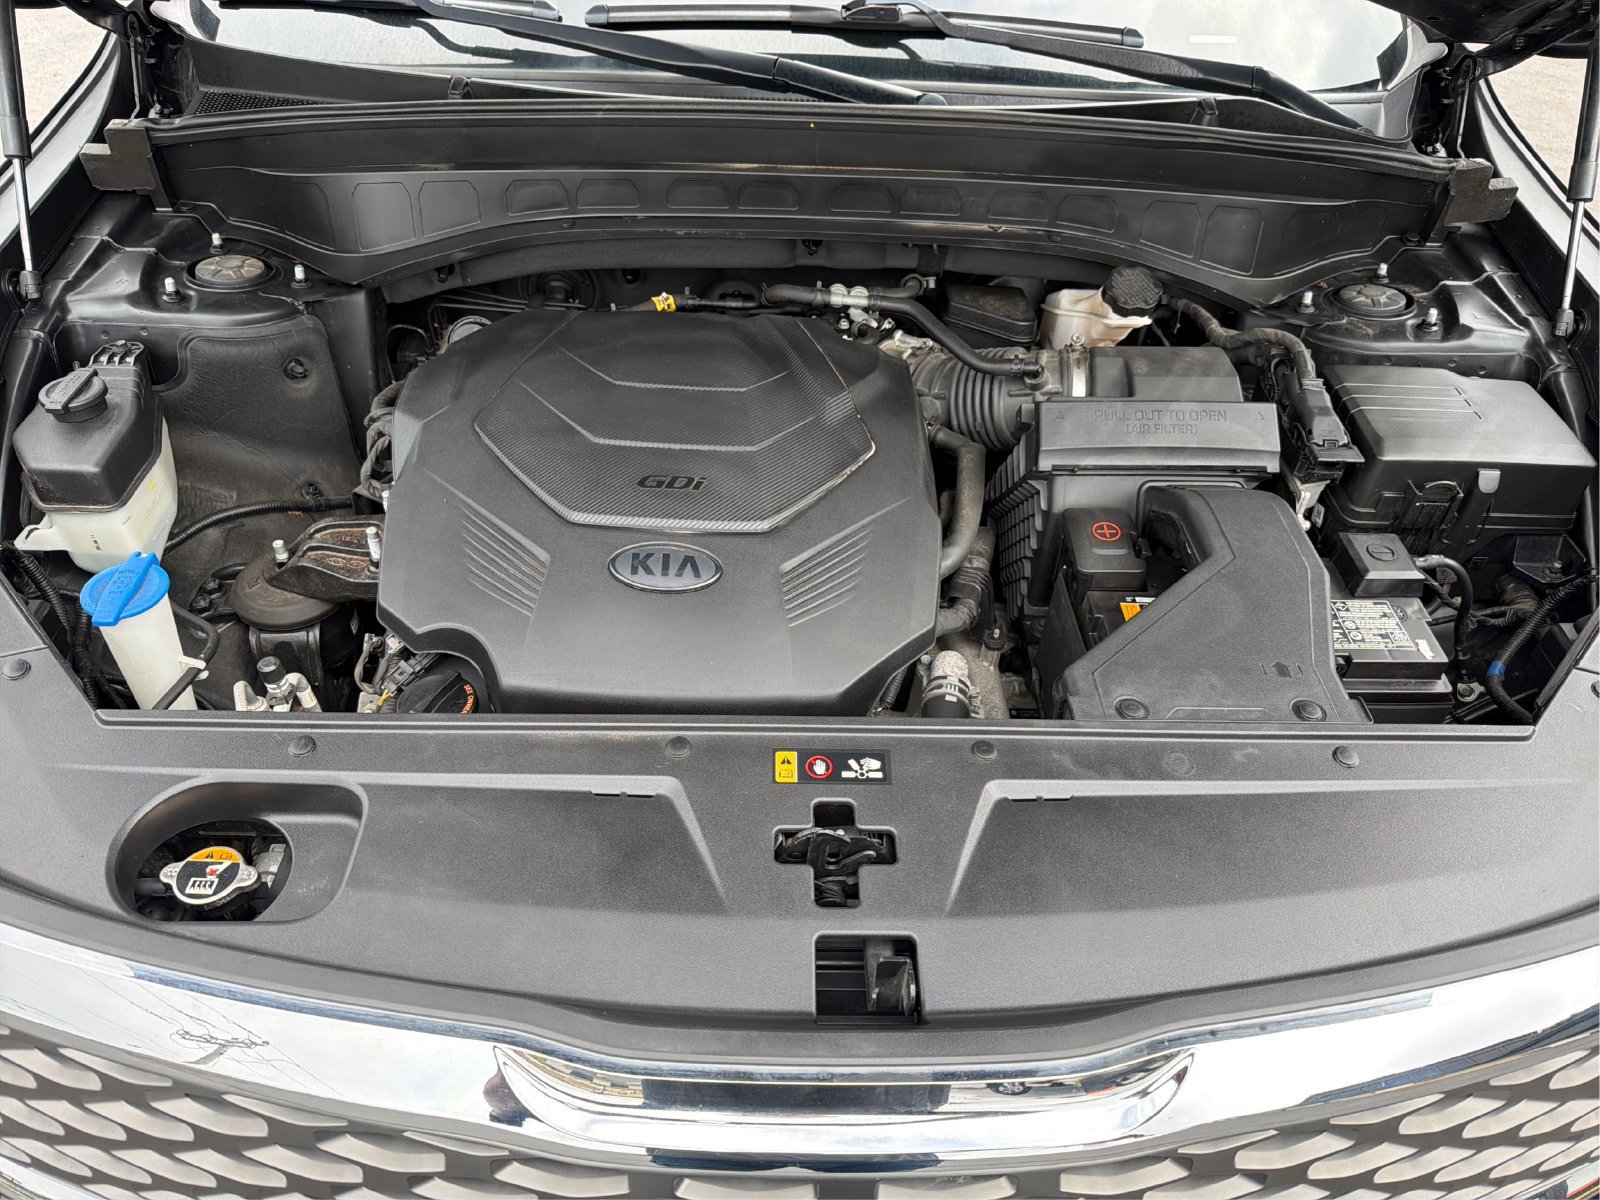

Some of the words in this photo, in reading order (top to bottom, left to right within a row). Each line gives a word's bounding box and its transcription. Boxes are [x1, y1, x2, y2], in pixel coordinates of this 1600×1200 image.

[1093, 409, 1131, 421] PULL
[1134, 409, 1163, 421] OUT
[1168, 409, 1185, 421] TO
[1189, 409, 1227, 422] OPEN
[637, 475, 708, 491] GDi
[630, 552, 702, 579] KIA
